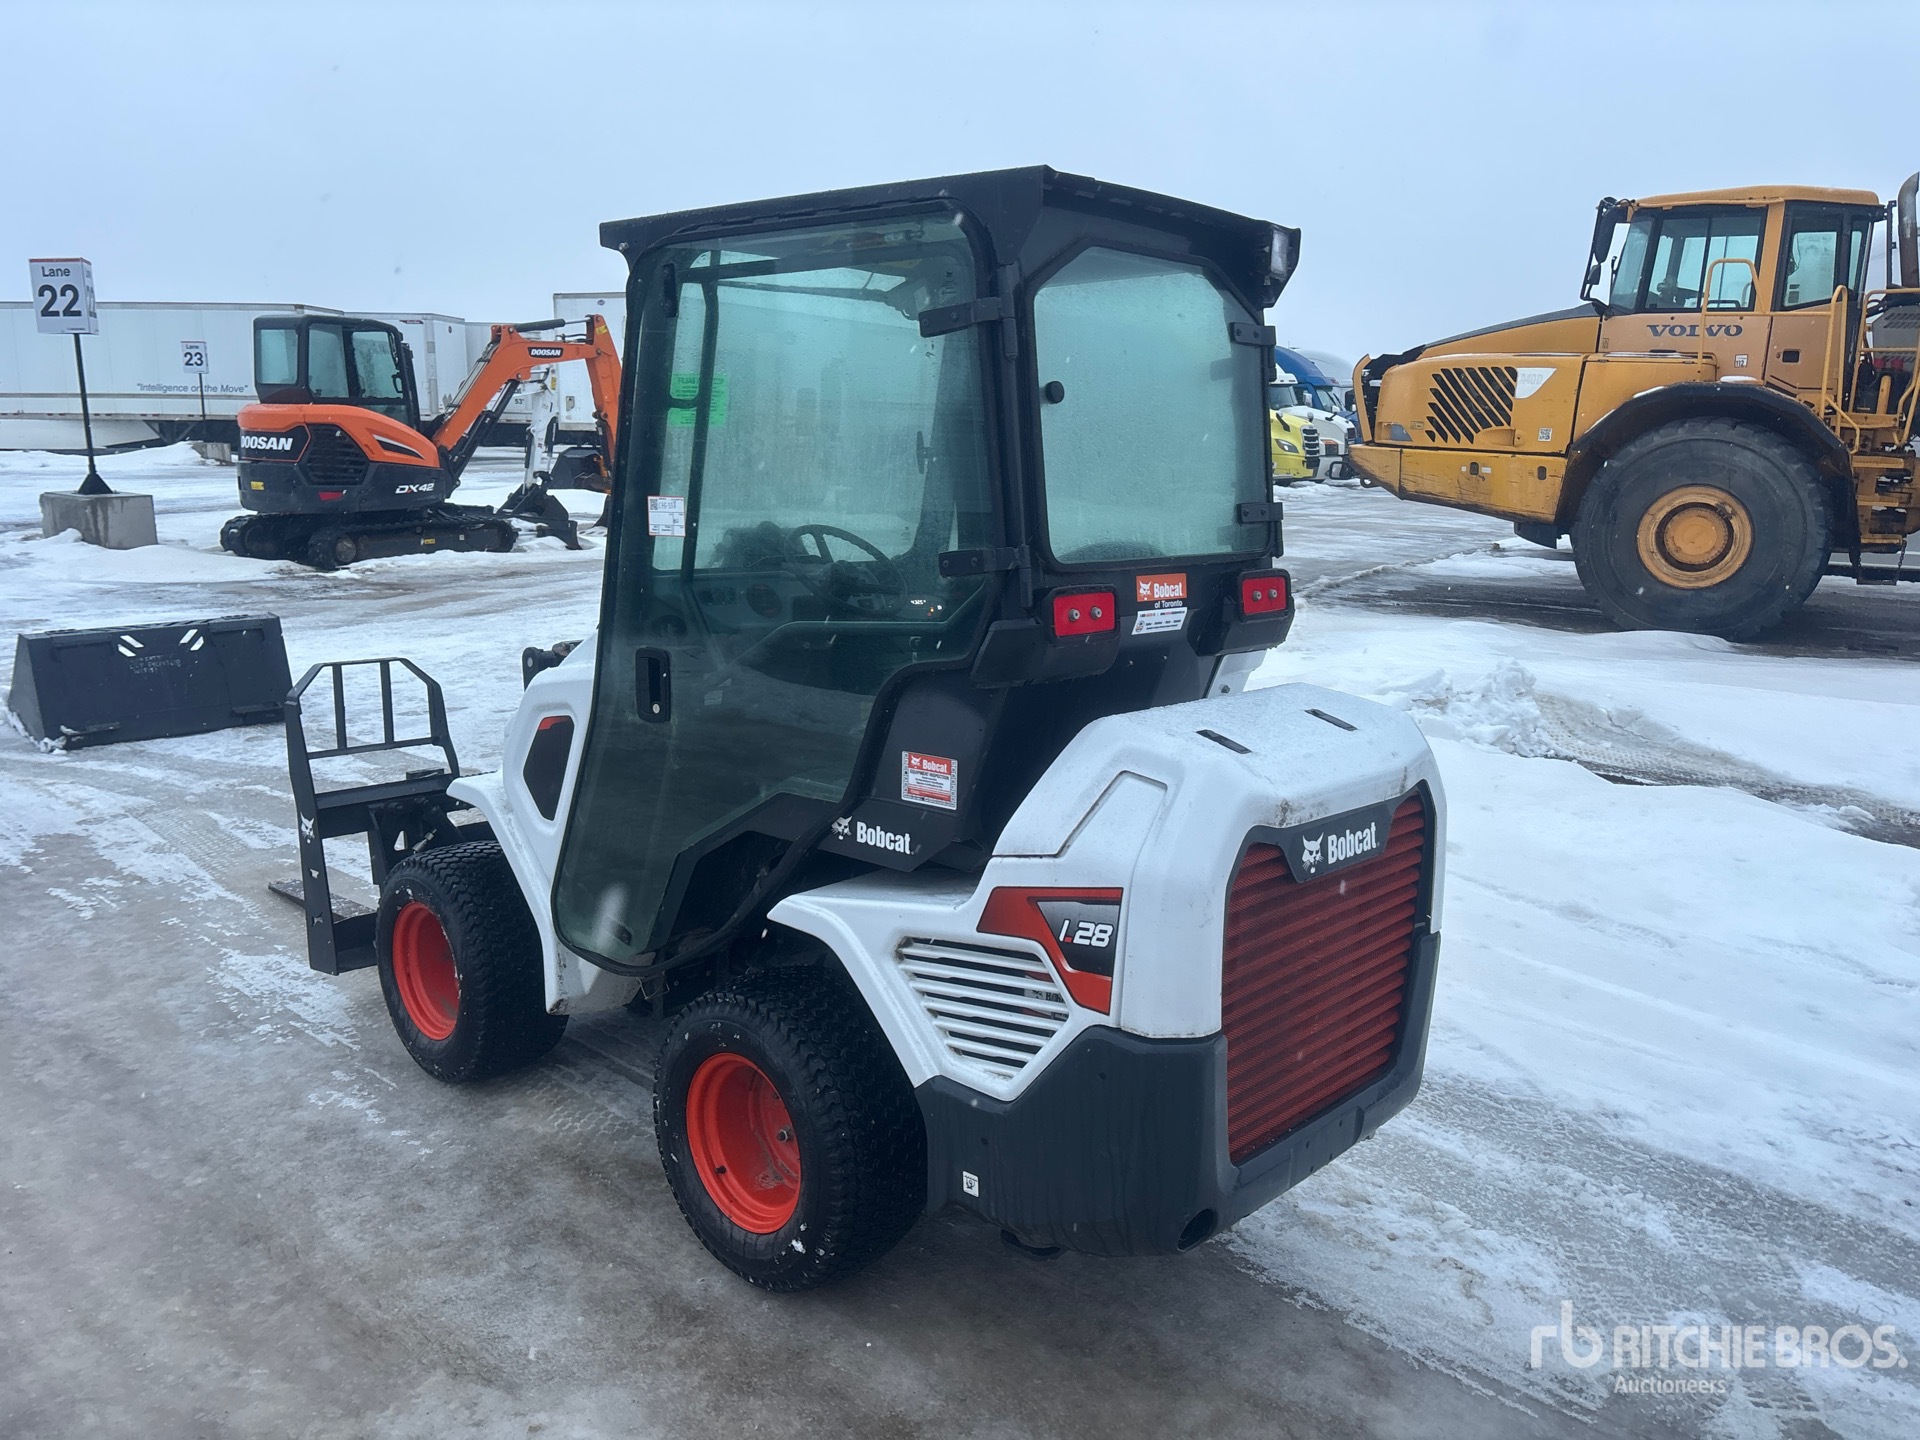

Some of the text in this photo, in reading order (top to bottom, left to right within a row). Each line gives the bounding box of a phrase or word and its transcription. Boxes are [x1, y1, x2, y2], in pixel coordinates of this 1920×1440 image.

[41, 265, 71, 278] Lane
[38, 284, 82, 317] 22
[1647, 324, 1743, 337] VOLVO
[530, 347, 562, 357] DOOSAN
[184, 352, 204, 367] 23
[204, 385, 218, 393] the
[395, 482, 435, 494] DX42
[1153, 582, 1183, 599] Bobcat
[1154, 599, 1183, 609] of Toronto
[922, 759, 948, 774] Bobcat
[856, 821, 912, 856] Bobcat
[1327, 821, 1377, 865] Bobcat
